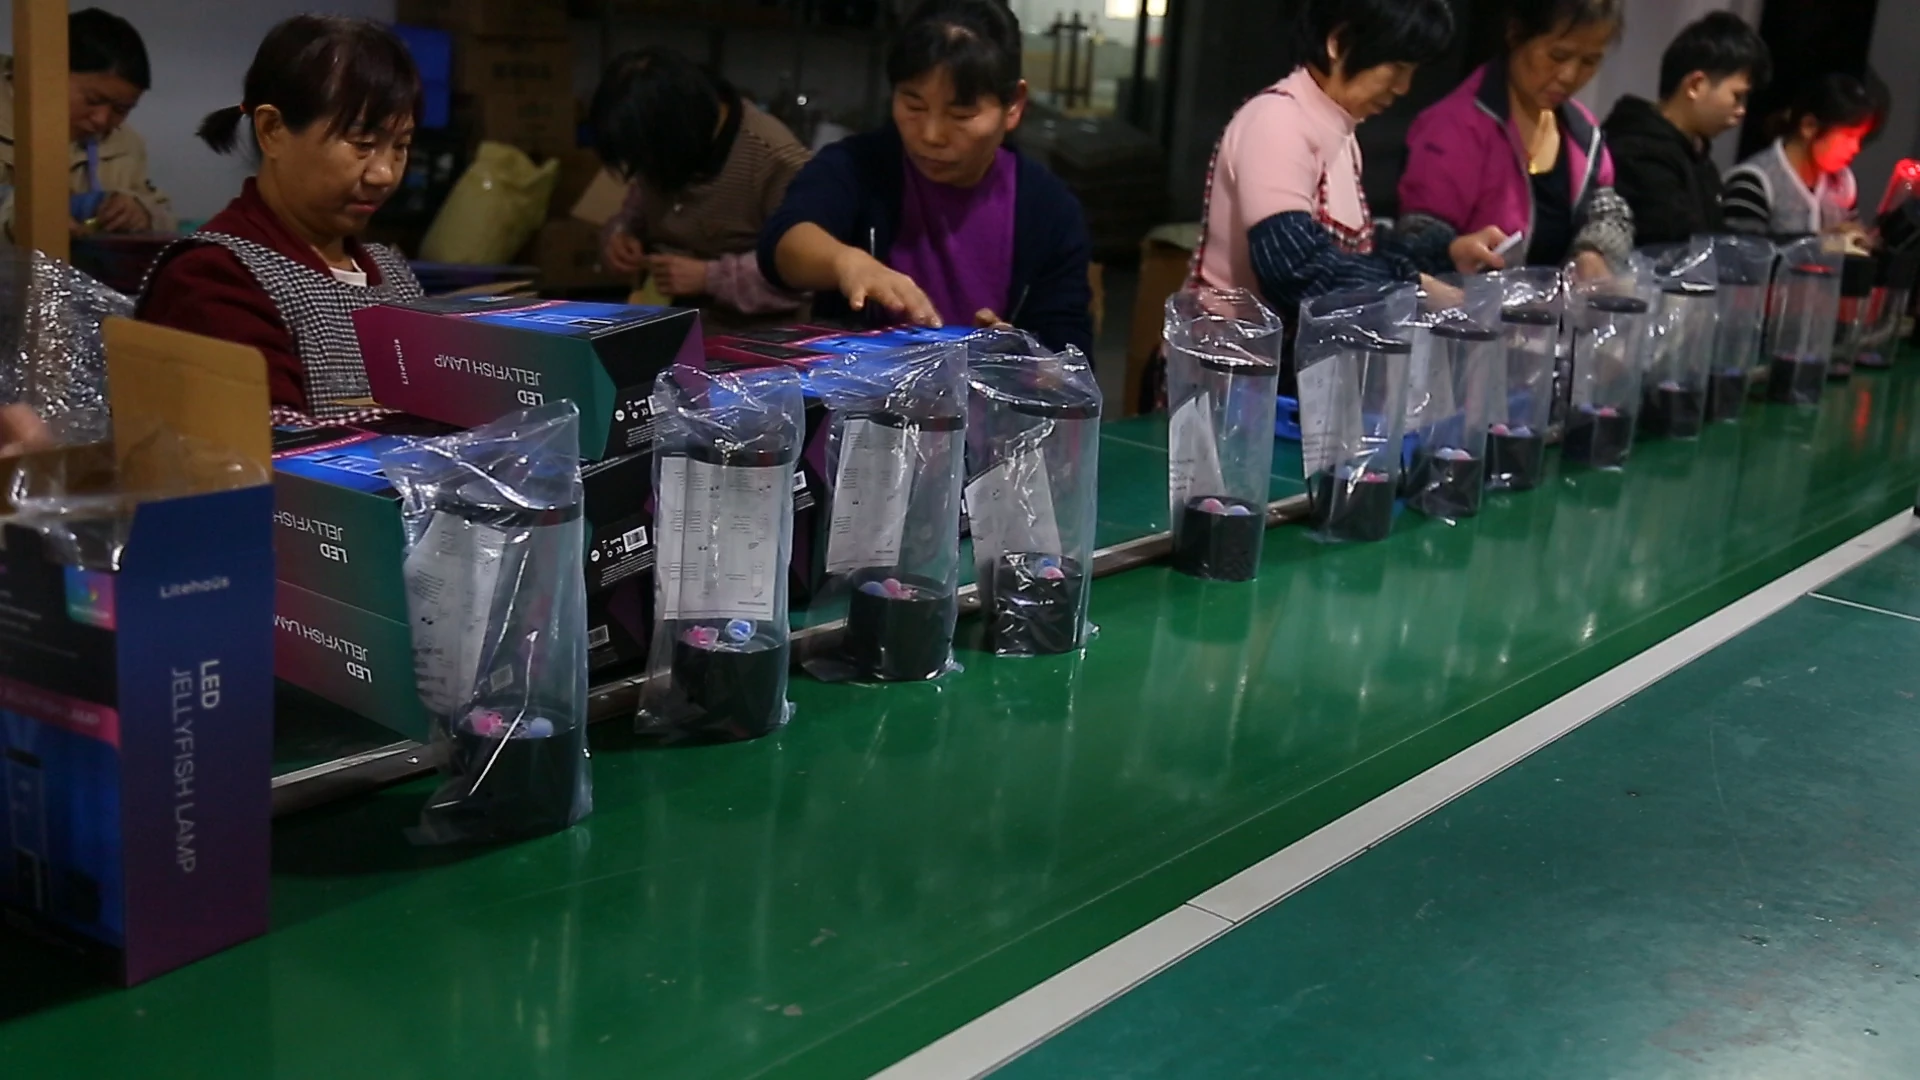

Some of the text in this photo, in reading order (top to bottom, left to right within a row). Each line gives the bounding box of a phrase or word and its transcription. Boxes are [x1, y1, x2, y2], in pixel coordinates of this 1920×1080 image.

[434, 353, 542, 387] JELLYFISH LAMP
[517, 389, 544, 406] LED
[273, 510, 344, 542] JELLYFISH
[319, 542, 349, 564] LED
[273, 613, 369, 663] JELLYFISH LAM
[200, 658, 220, 710] LED
[346, 661, 373, 684] LED
[171, 667, 197, 874] JELLYFISH LAMP
